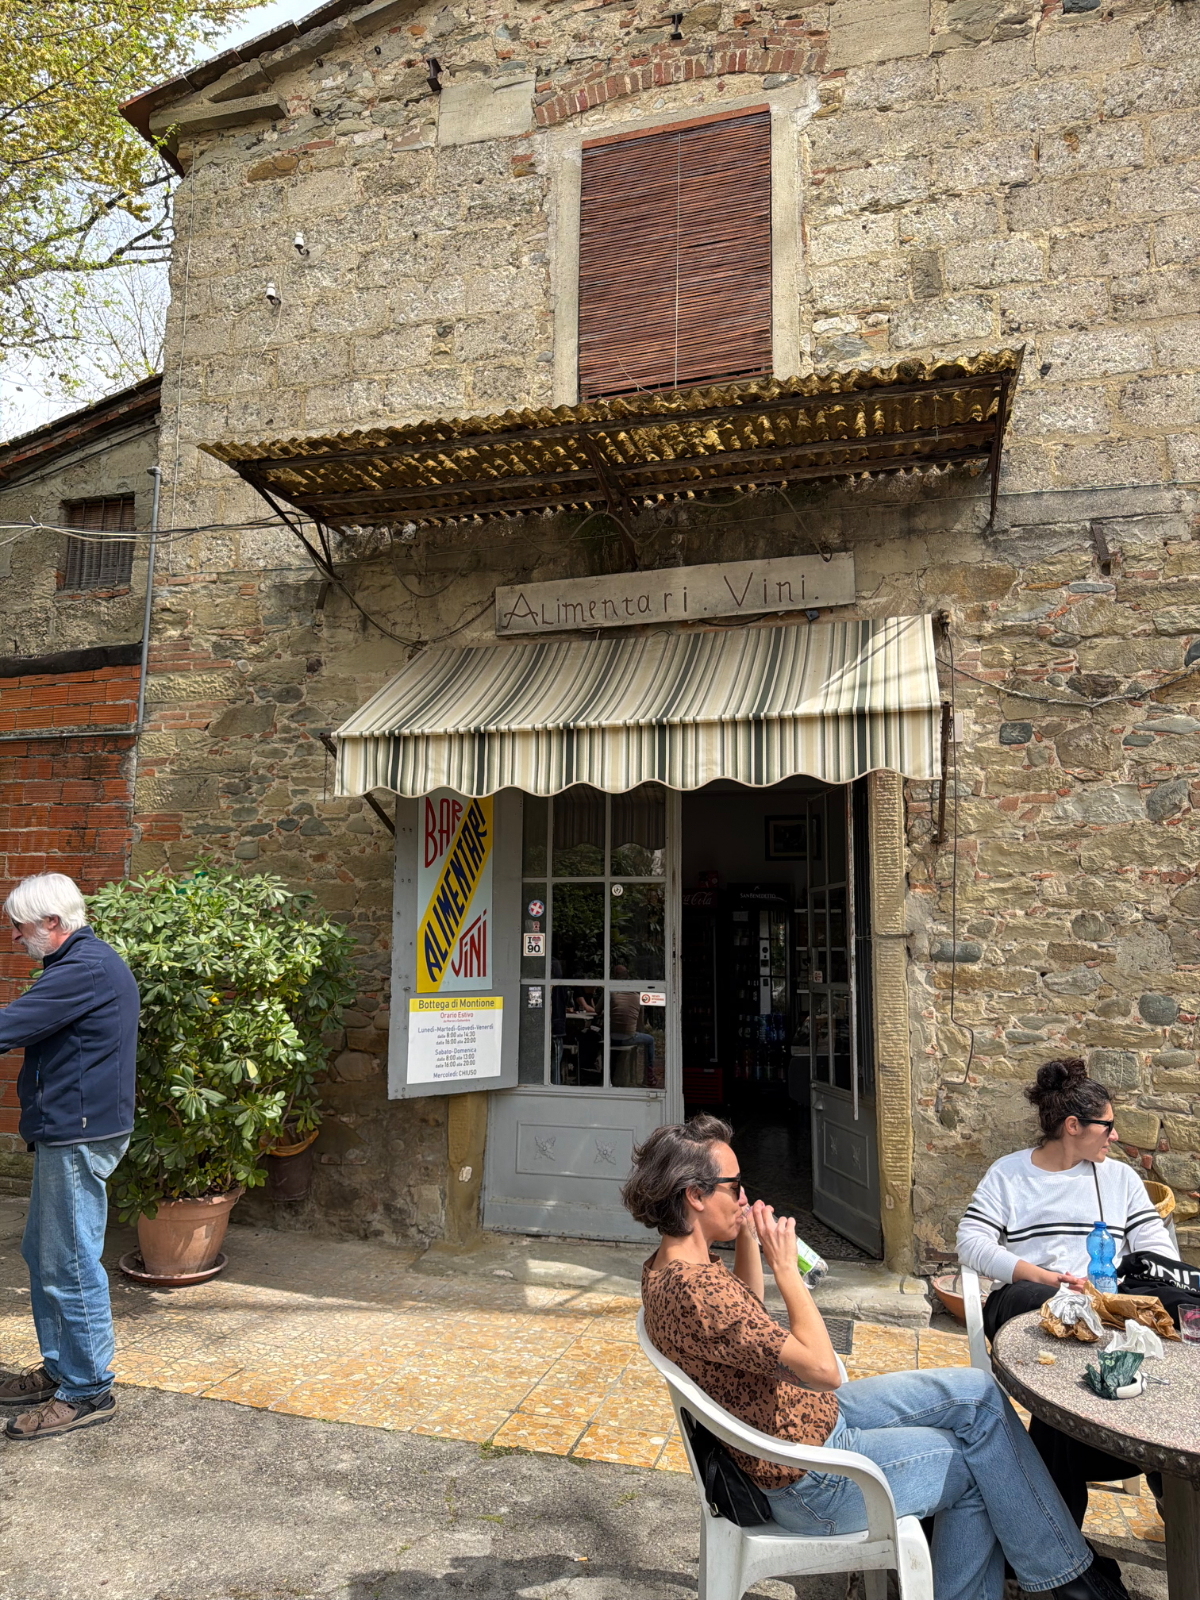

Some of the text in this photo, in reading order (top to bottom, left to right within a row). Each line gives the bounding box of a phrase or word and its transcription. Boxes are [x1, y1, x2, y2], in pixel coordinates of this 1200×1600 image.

[723, 571, 819, 608] Vini.
[424, 796, 463, 869] BAR
[424, 797, 487, 983] ALIMENTARI
[418, 998, 495, 1010] Bottega di Montione
[458, 1069, 477, 1077] CHIUSO
